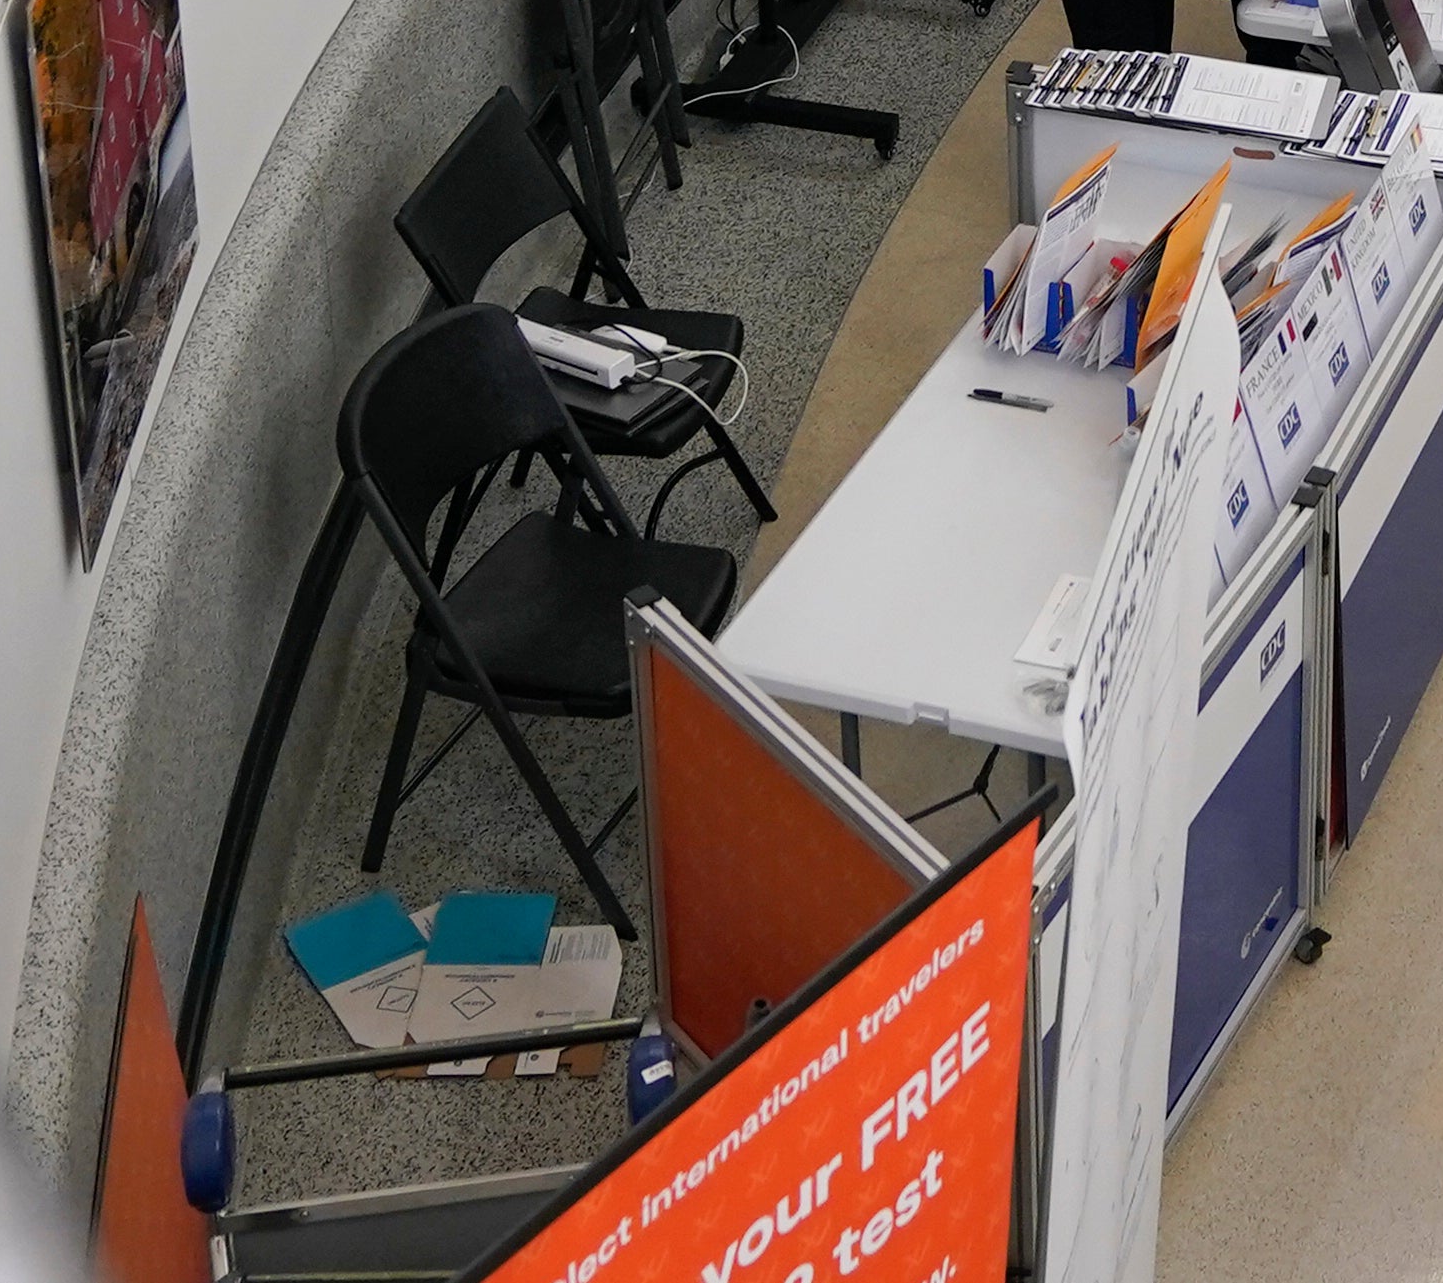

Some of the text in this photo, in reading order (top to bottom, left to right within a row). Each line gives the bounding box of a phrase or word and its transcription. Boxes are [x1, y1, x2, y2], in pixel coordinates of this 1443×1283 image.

[1297, 280, 1324, 322] MEXICO
[1246, 345, 1281, 399] FRANCE
[1329, 342, 1349, 380] CDC
[1278, 403, 1301, 443] CDC
[1227, 480, 1249, 524] CDC
[1260, 621, 1285, 677] CDC
[550, 920, 984, 1283] lect international travelers
[701, 1000, 991, 1283] your FREE
[833, 1150, 944, 1276] test
